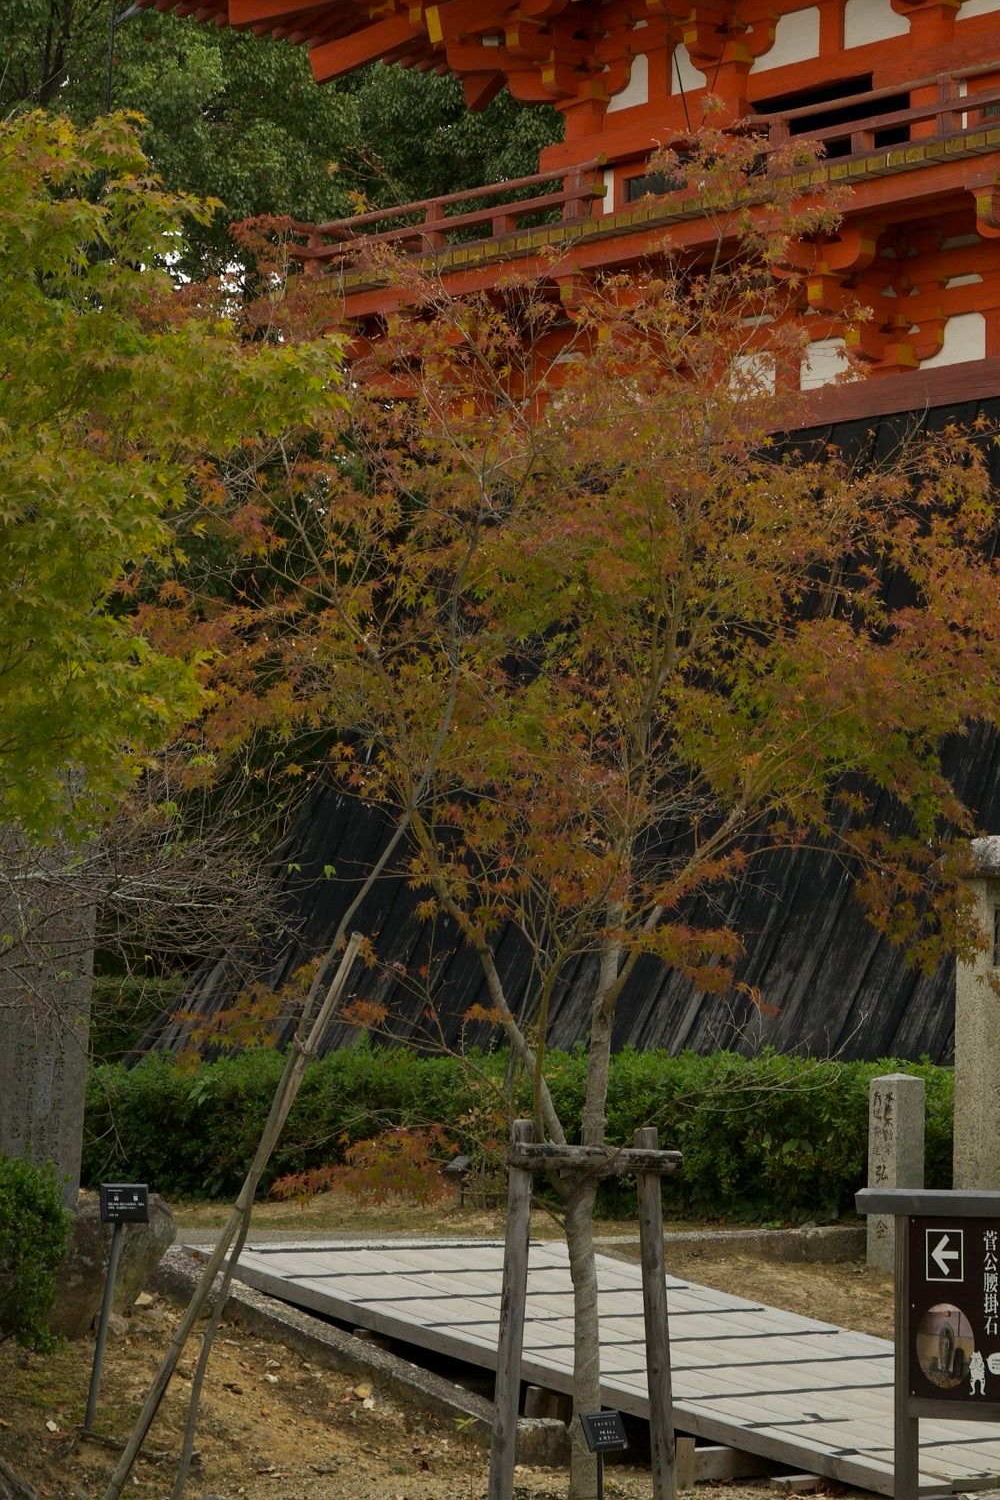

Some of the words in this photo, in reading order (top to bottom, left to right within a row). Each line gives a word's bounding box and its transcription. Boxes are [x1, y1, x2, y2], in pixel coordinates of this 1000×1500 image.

[983, 1230, 999, 1335] 菅公腰掛石
